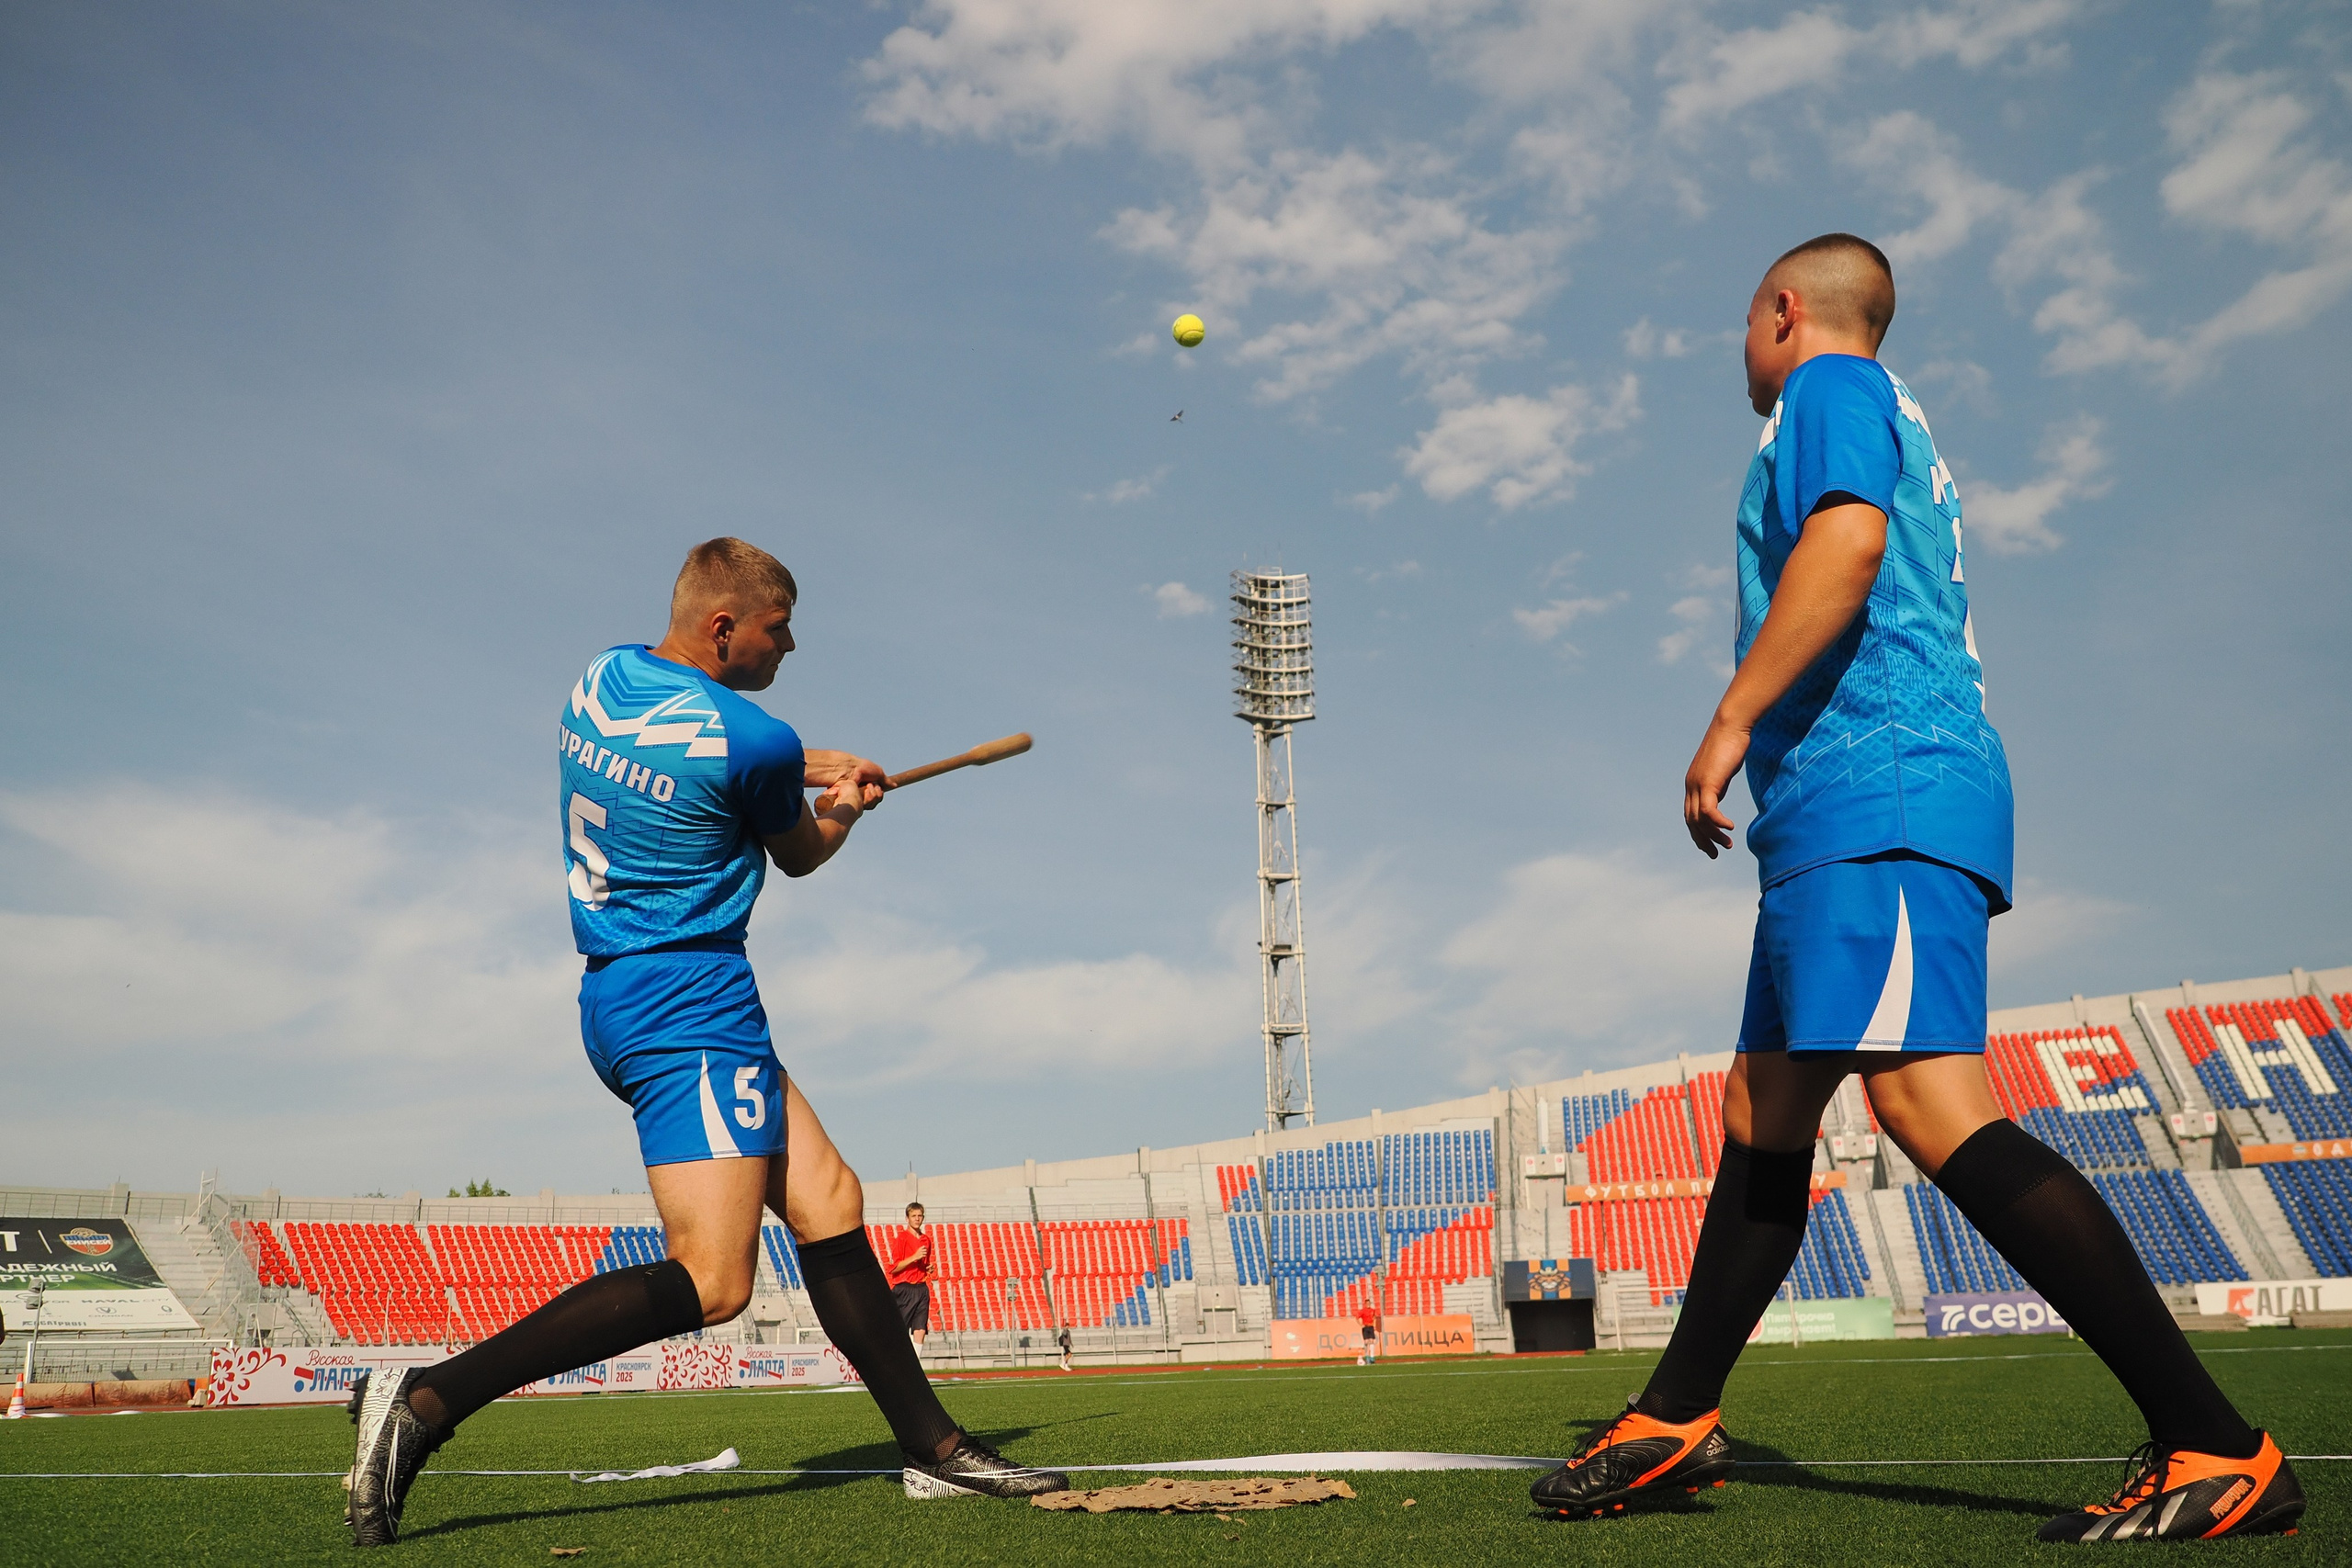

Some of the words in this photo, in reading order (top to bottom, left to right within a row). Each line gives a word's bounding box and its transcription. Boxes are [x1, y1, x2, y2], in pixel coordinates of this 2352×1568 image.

[560, 721, 675, 802] УРАГИНО
[568, 791, 610, 911] 5
[733, 1066, 766, 1131] 5
[1584, 1182, 1675, 1199] ФУТБОЛ
[0, 1274, 75, 1283] РТНЕР
[1767, 1324, 1837, 1337] вырчает!
[1383, 1330, 1464, 1348] ПИЦЦА
[305, 1349, 356, 1366] Русская
[744, 1346, 774, 1359] Русская
[616, 1362, 652, 1371] КРАСНОЯРСК
[747, 1359, 786, 1378] ЛАПТА
[791, 1359, 820, 1367] КРАСНОЯРСК
[616, 1371, 634, 1383] 2025
[791, 1367, 806, 1377] 2025
